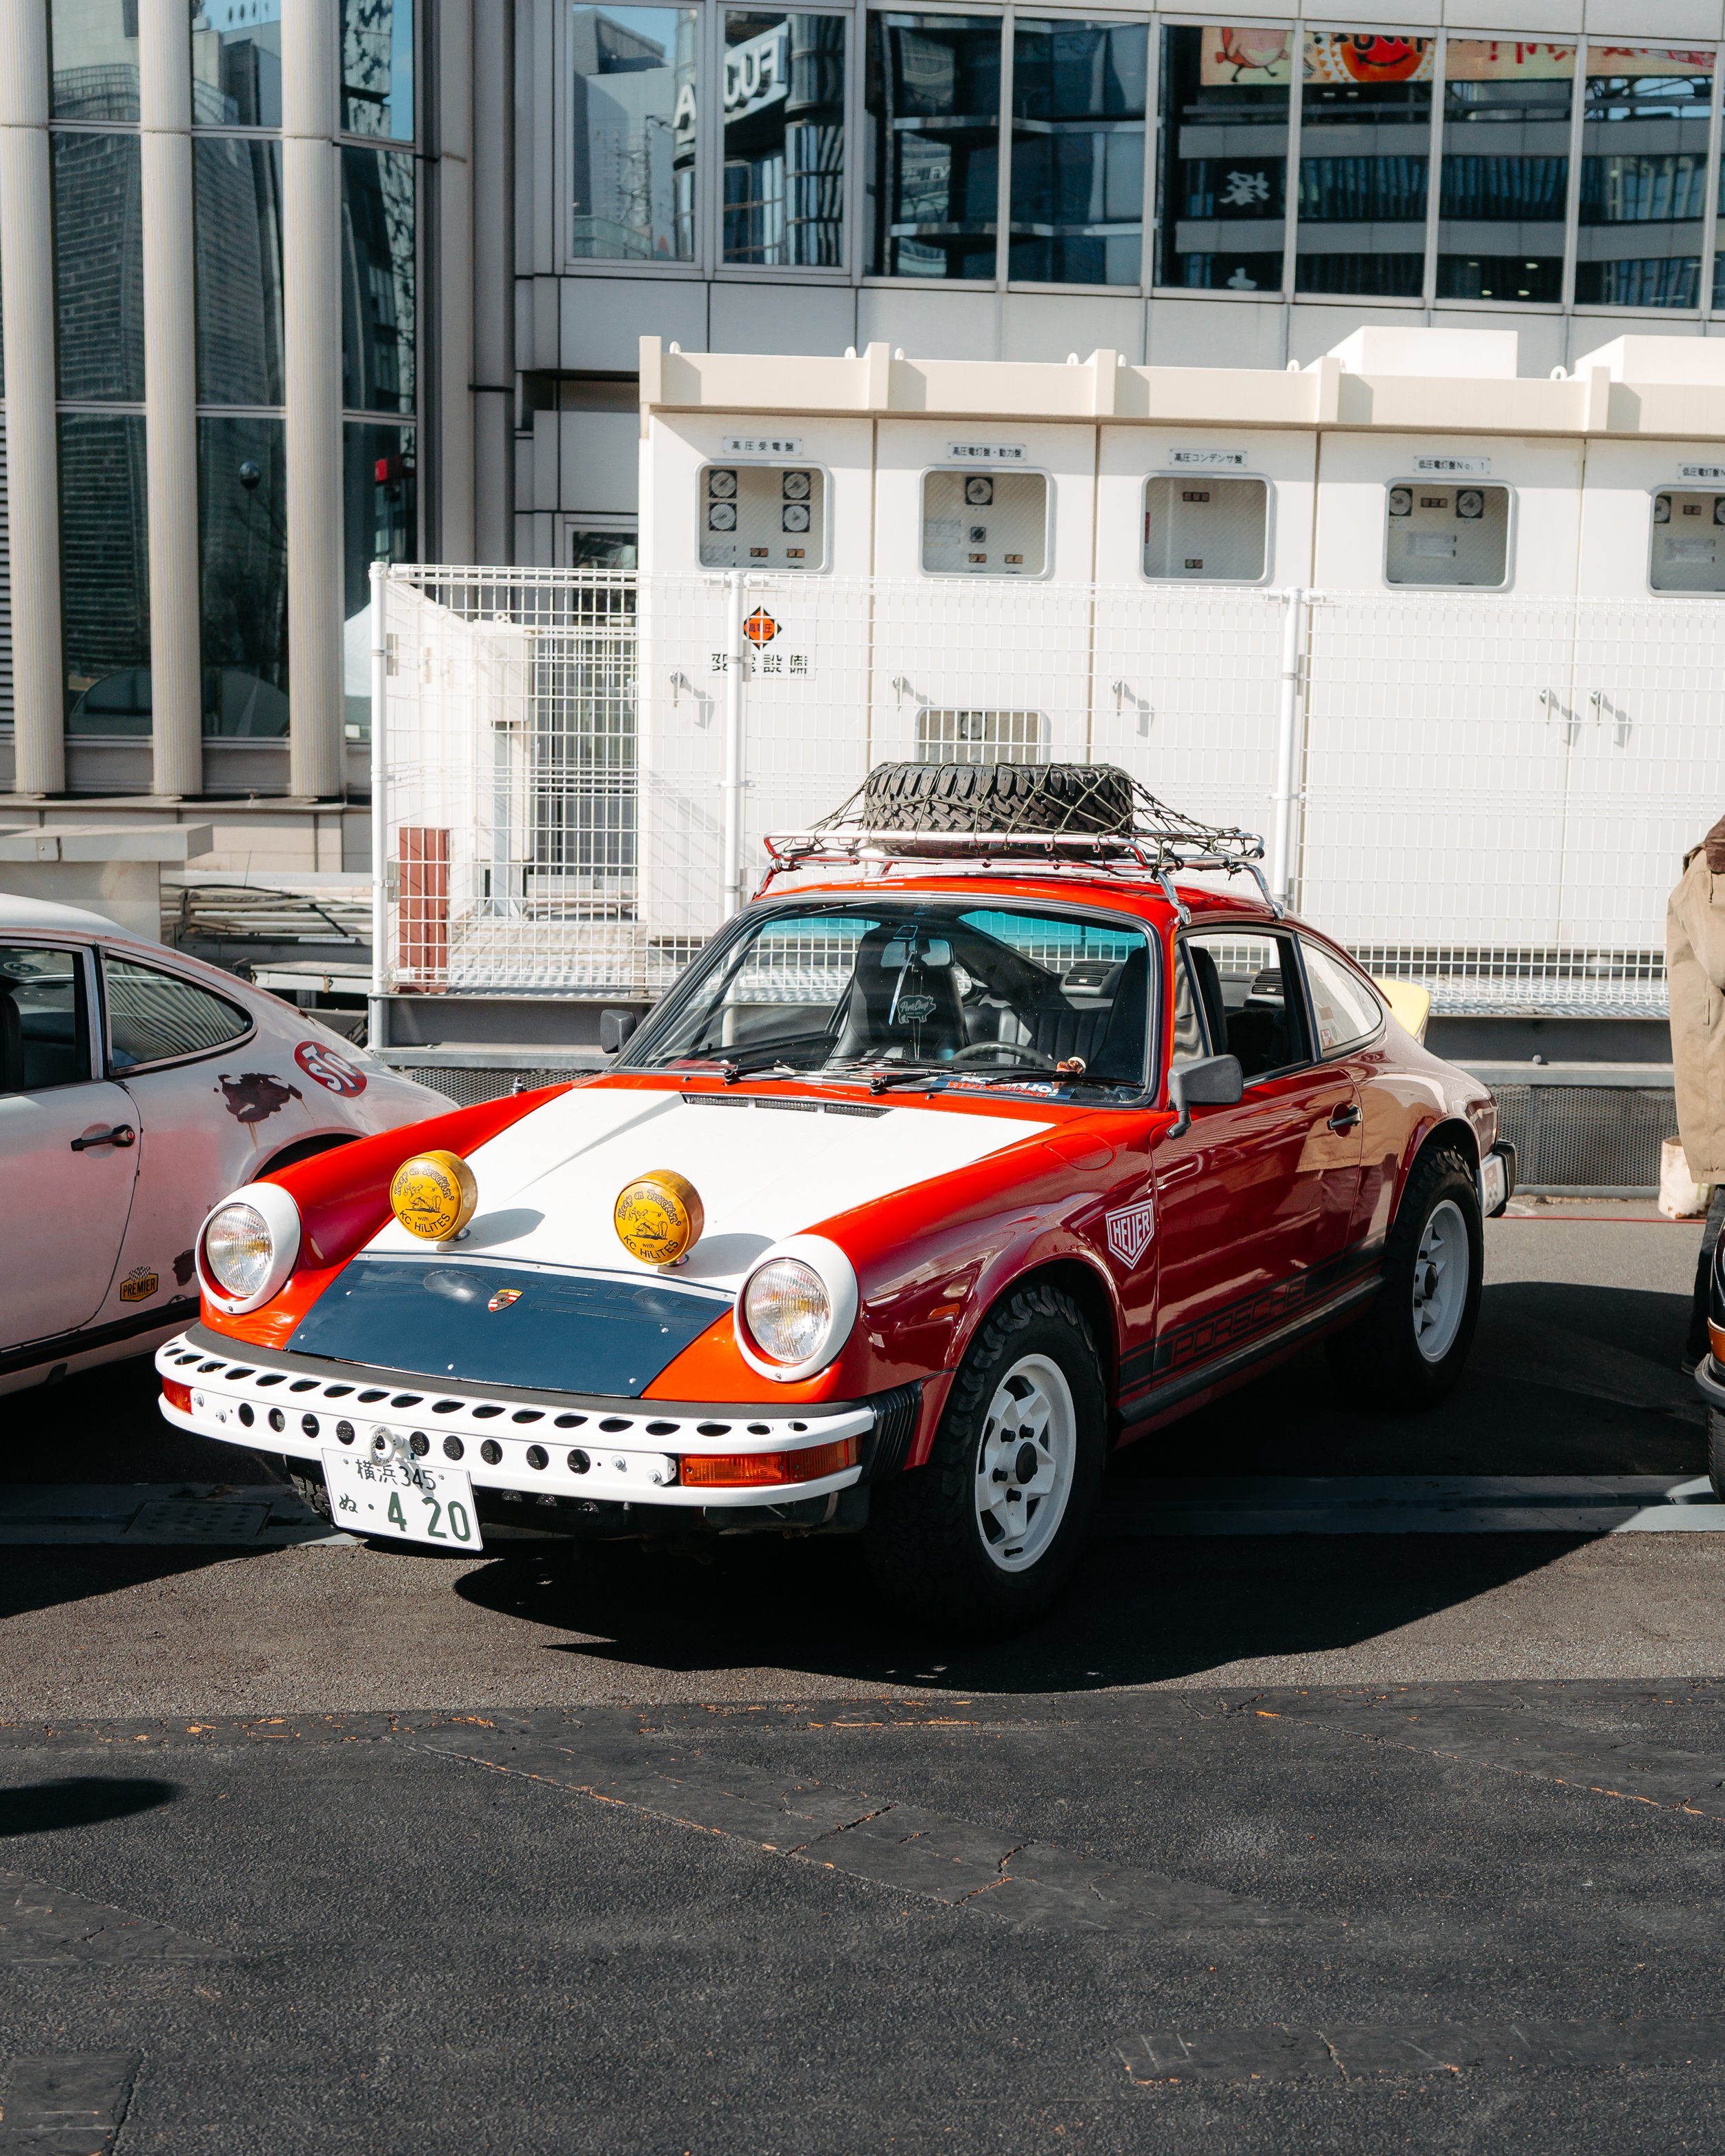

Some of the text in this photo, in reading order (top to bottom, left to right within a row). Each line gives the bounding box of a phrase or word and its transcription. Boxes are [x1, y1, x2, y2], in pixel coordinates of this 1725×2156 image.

[1175, 453, 1242, 464] 高圧コンデンサ盤
[302, 1044, 360, 1093] STP
[394, 1171, 408, 1196] Keep
[400, 1210, 412, 1225] KC
[618, 1194, 633, 1220] Keep
[623, 1235, 637, 1250] KC
[1112, 1211, 1150, 1256] HEUER
[123, 1278, 156, 1298] PREMIER
[1172, 1275, 1306, 1365] PORSCHE
